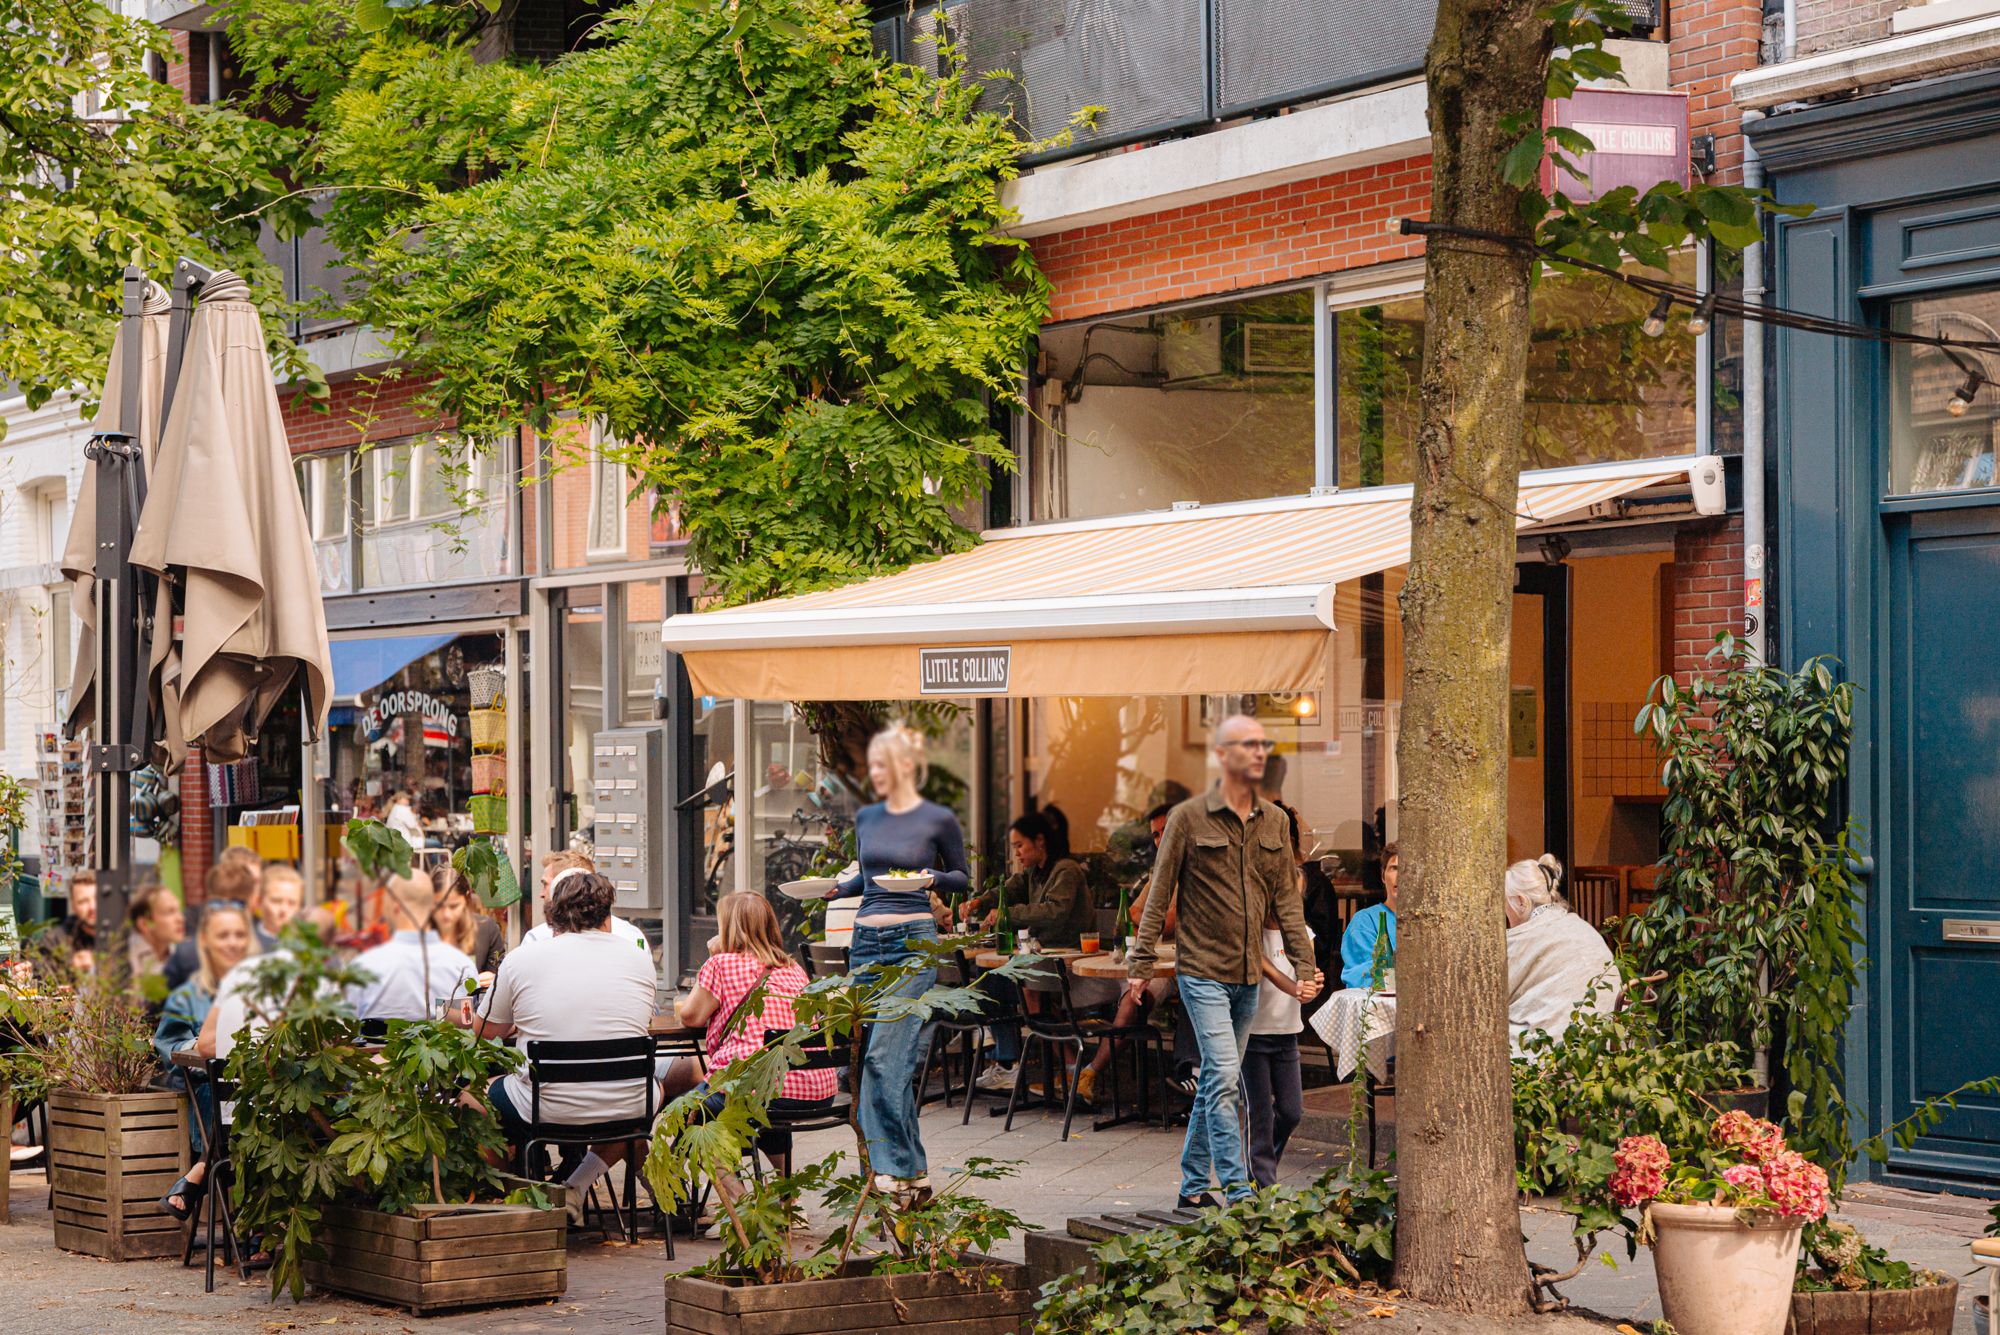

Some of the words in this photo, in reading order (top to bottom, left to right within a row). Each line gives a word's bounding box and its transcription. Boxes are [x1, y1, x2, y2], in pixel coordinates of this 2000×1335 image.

[1621, 129, 1672, 151] COLLINS
[925, 658, 959, 683] LITTLE
[962, 656, 1005, 682] COLLINS
[361, 707, 382, 737] DE
[380, 690, 458, 737] OORSPRONG
[1340, 711, 1366, 727] LITTLE
